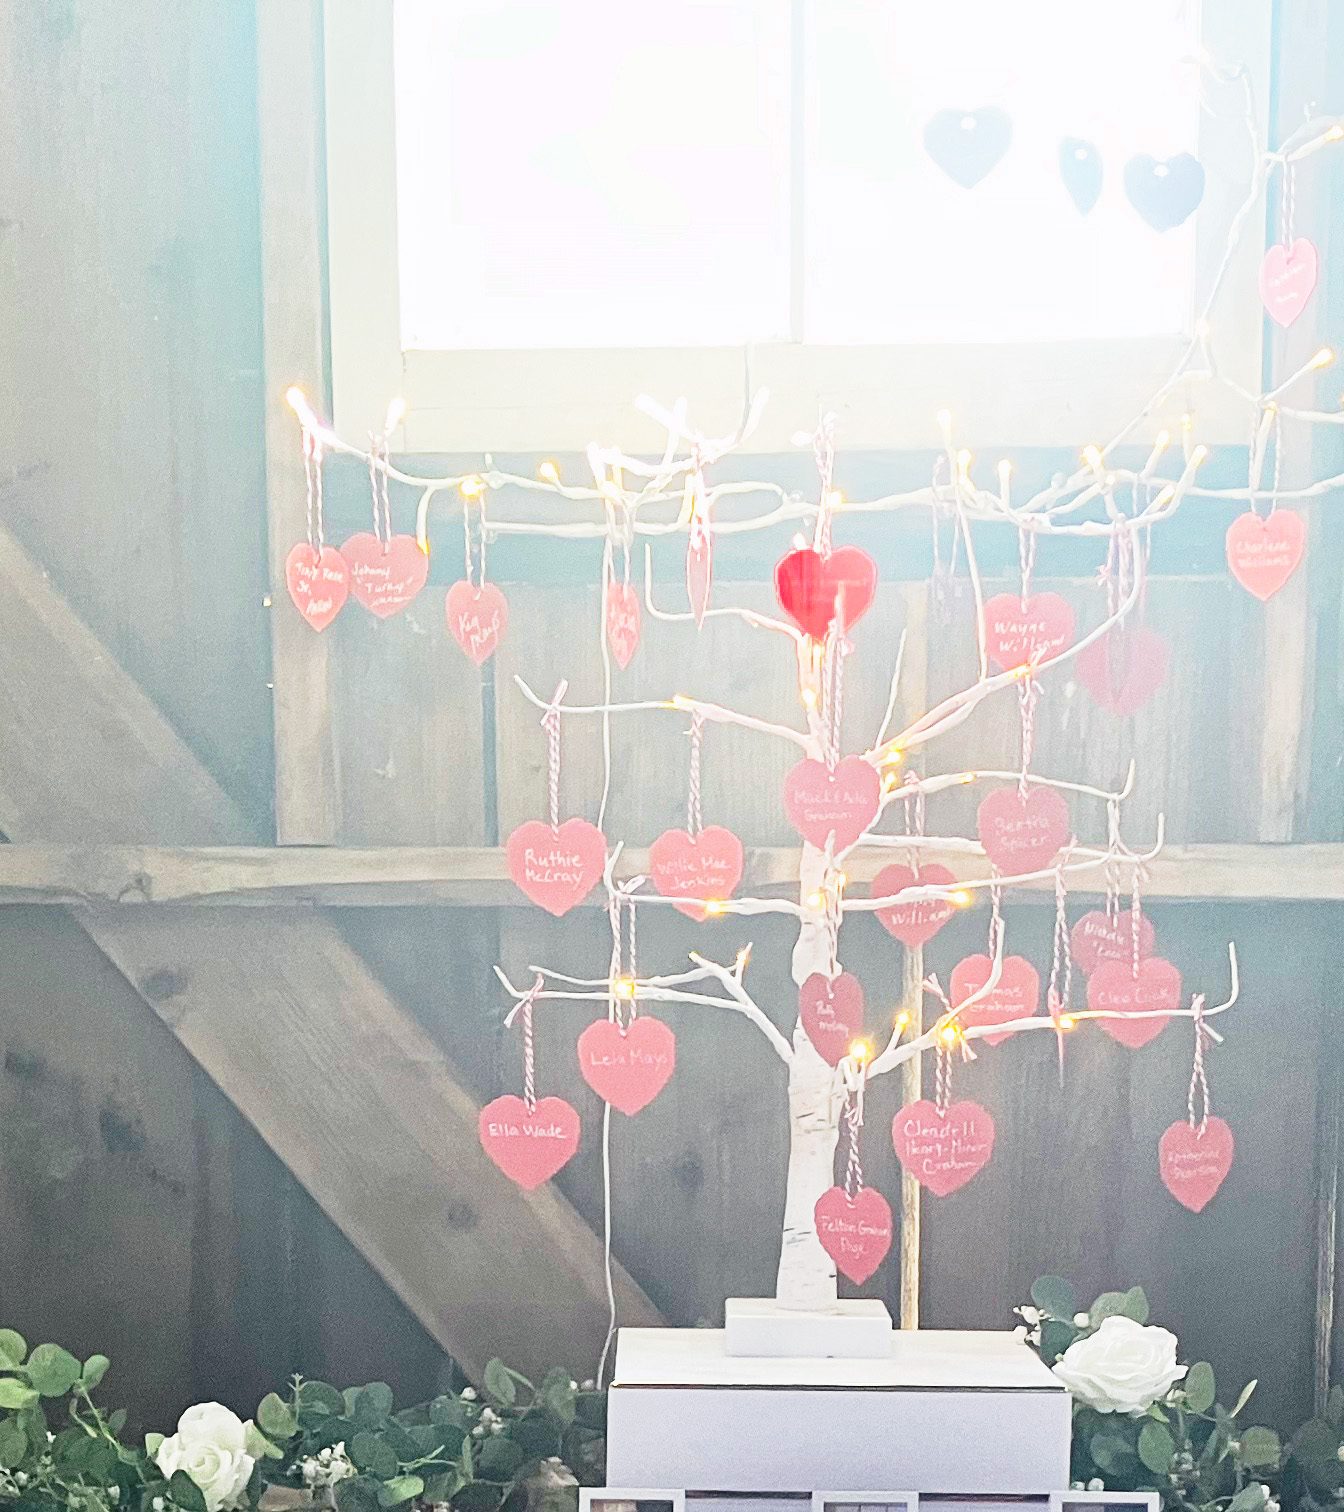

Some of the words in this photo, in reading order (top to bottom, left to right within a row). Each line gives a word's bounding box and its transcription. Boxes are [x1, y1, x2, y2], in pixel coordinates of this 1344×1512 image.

[995, 622, 1047, 636] Wayne
[524, 848, 584, 868] Ruthie
[525, 868, 585, 890] McCray
[488, 1123, 521, 1138] Ella
[522, 1123, 567, 1139] Wade
